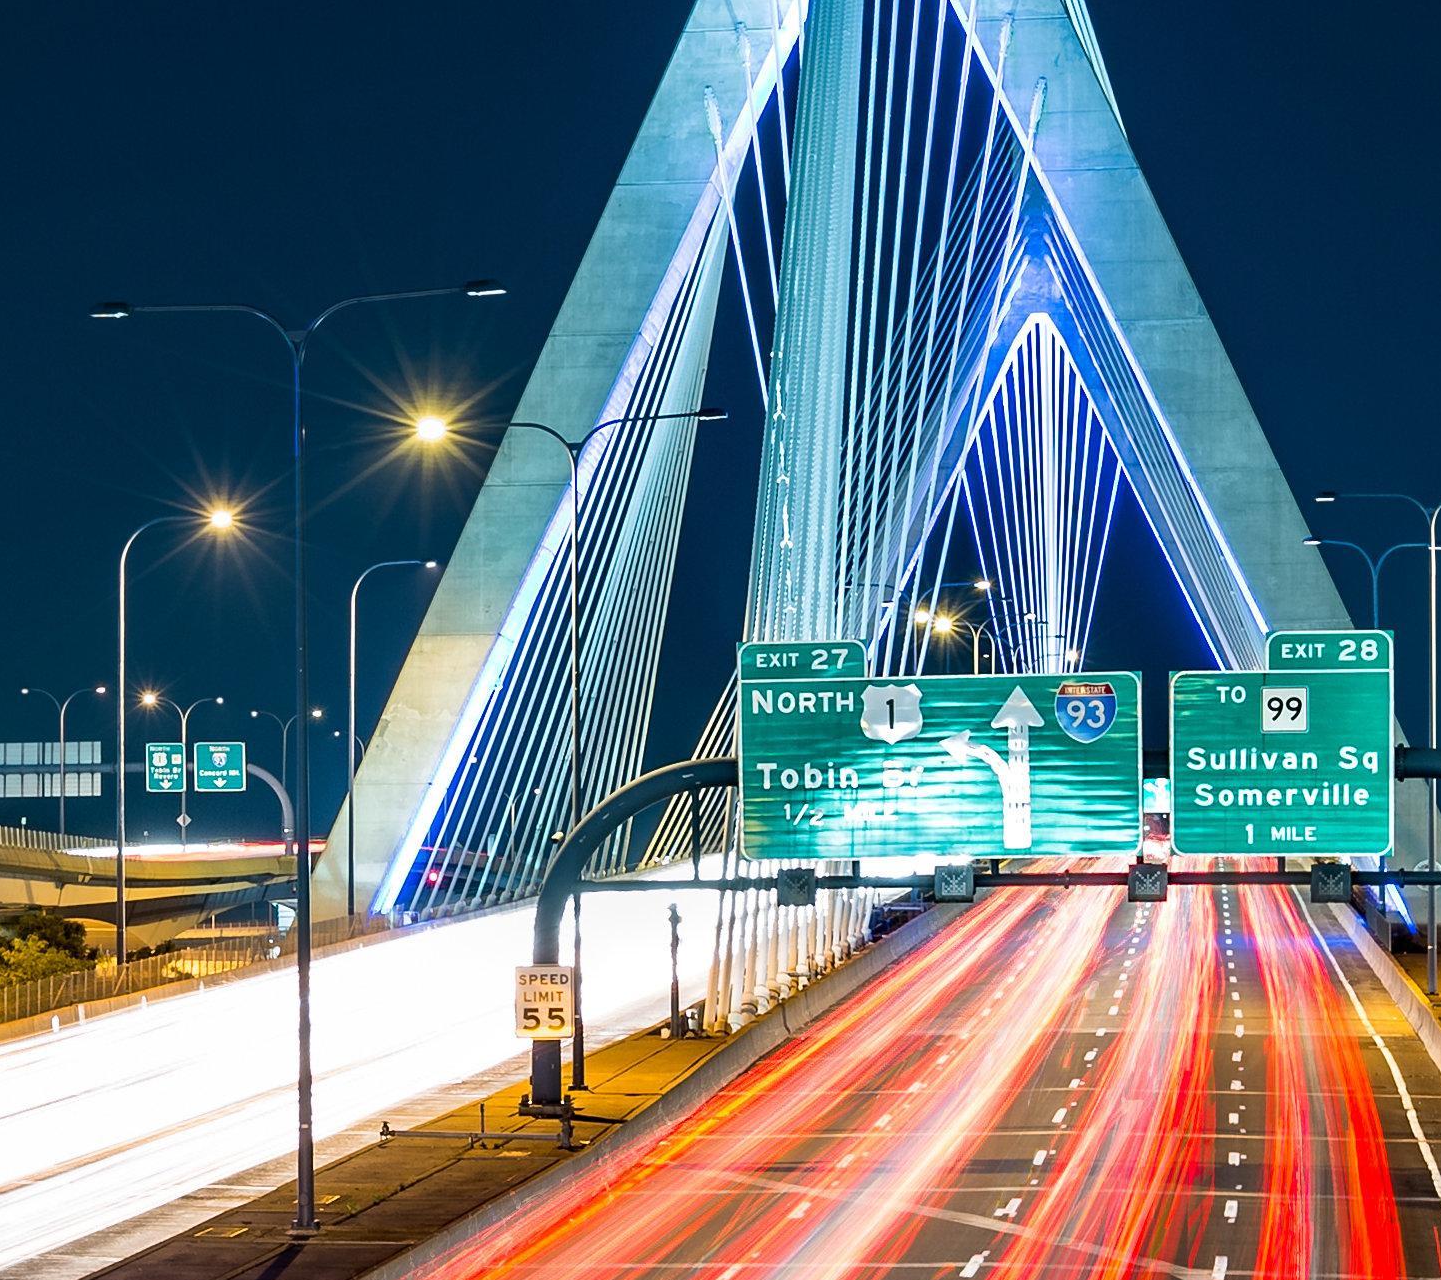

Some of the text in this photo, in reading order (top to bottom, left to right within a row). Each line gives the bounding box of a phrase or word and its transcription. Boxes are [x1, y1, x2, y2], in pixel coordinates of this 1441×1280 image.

[756, 648, 849, 670] EXIT 27
[1281, 639, 1379, 661] EXIT 28
[1064, 685, 1107, 695] INTERSTATE
[1216, 685, 1247, 704] TO
[751, 689, 854, 715] NORTH
[1267, 696, 1303, 722] 99
[886, 698, 895, 730] 1
[1066, 700, 1106, 729] 93
[1186, 746, 1379, 774] Sullivan Sq
[756, 759, 925, 790] Tobin Br
[1193, 781, 1370, 807] Somerville
[783, 803, 825, 826] 1/2
[1245, 823, 1318, 845] 1 MILE
[519, 974, 569, 985] SPEED
[524, 991, 563, 1002] LIMIT
[523, 1008, 565, 1030] 55
